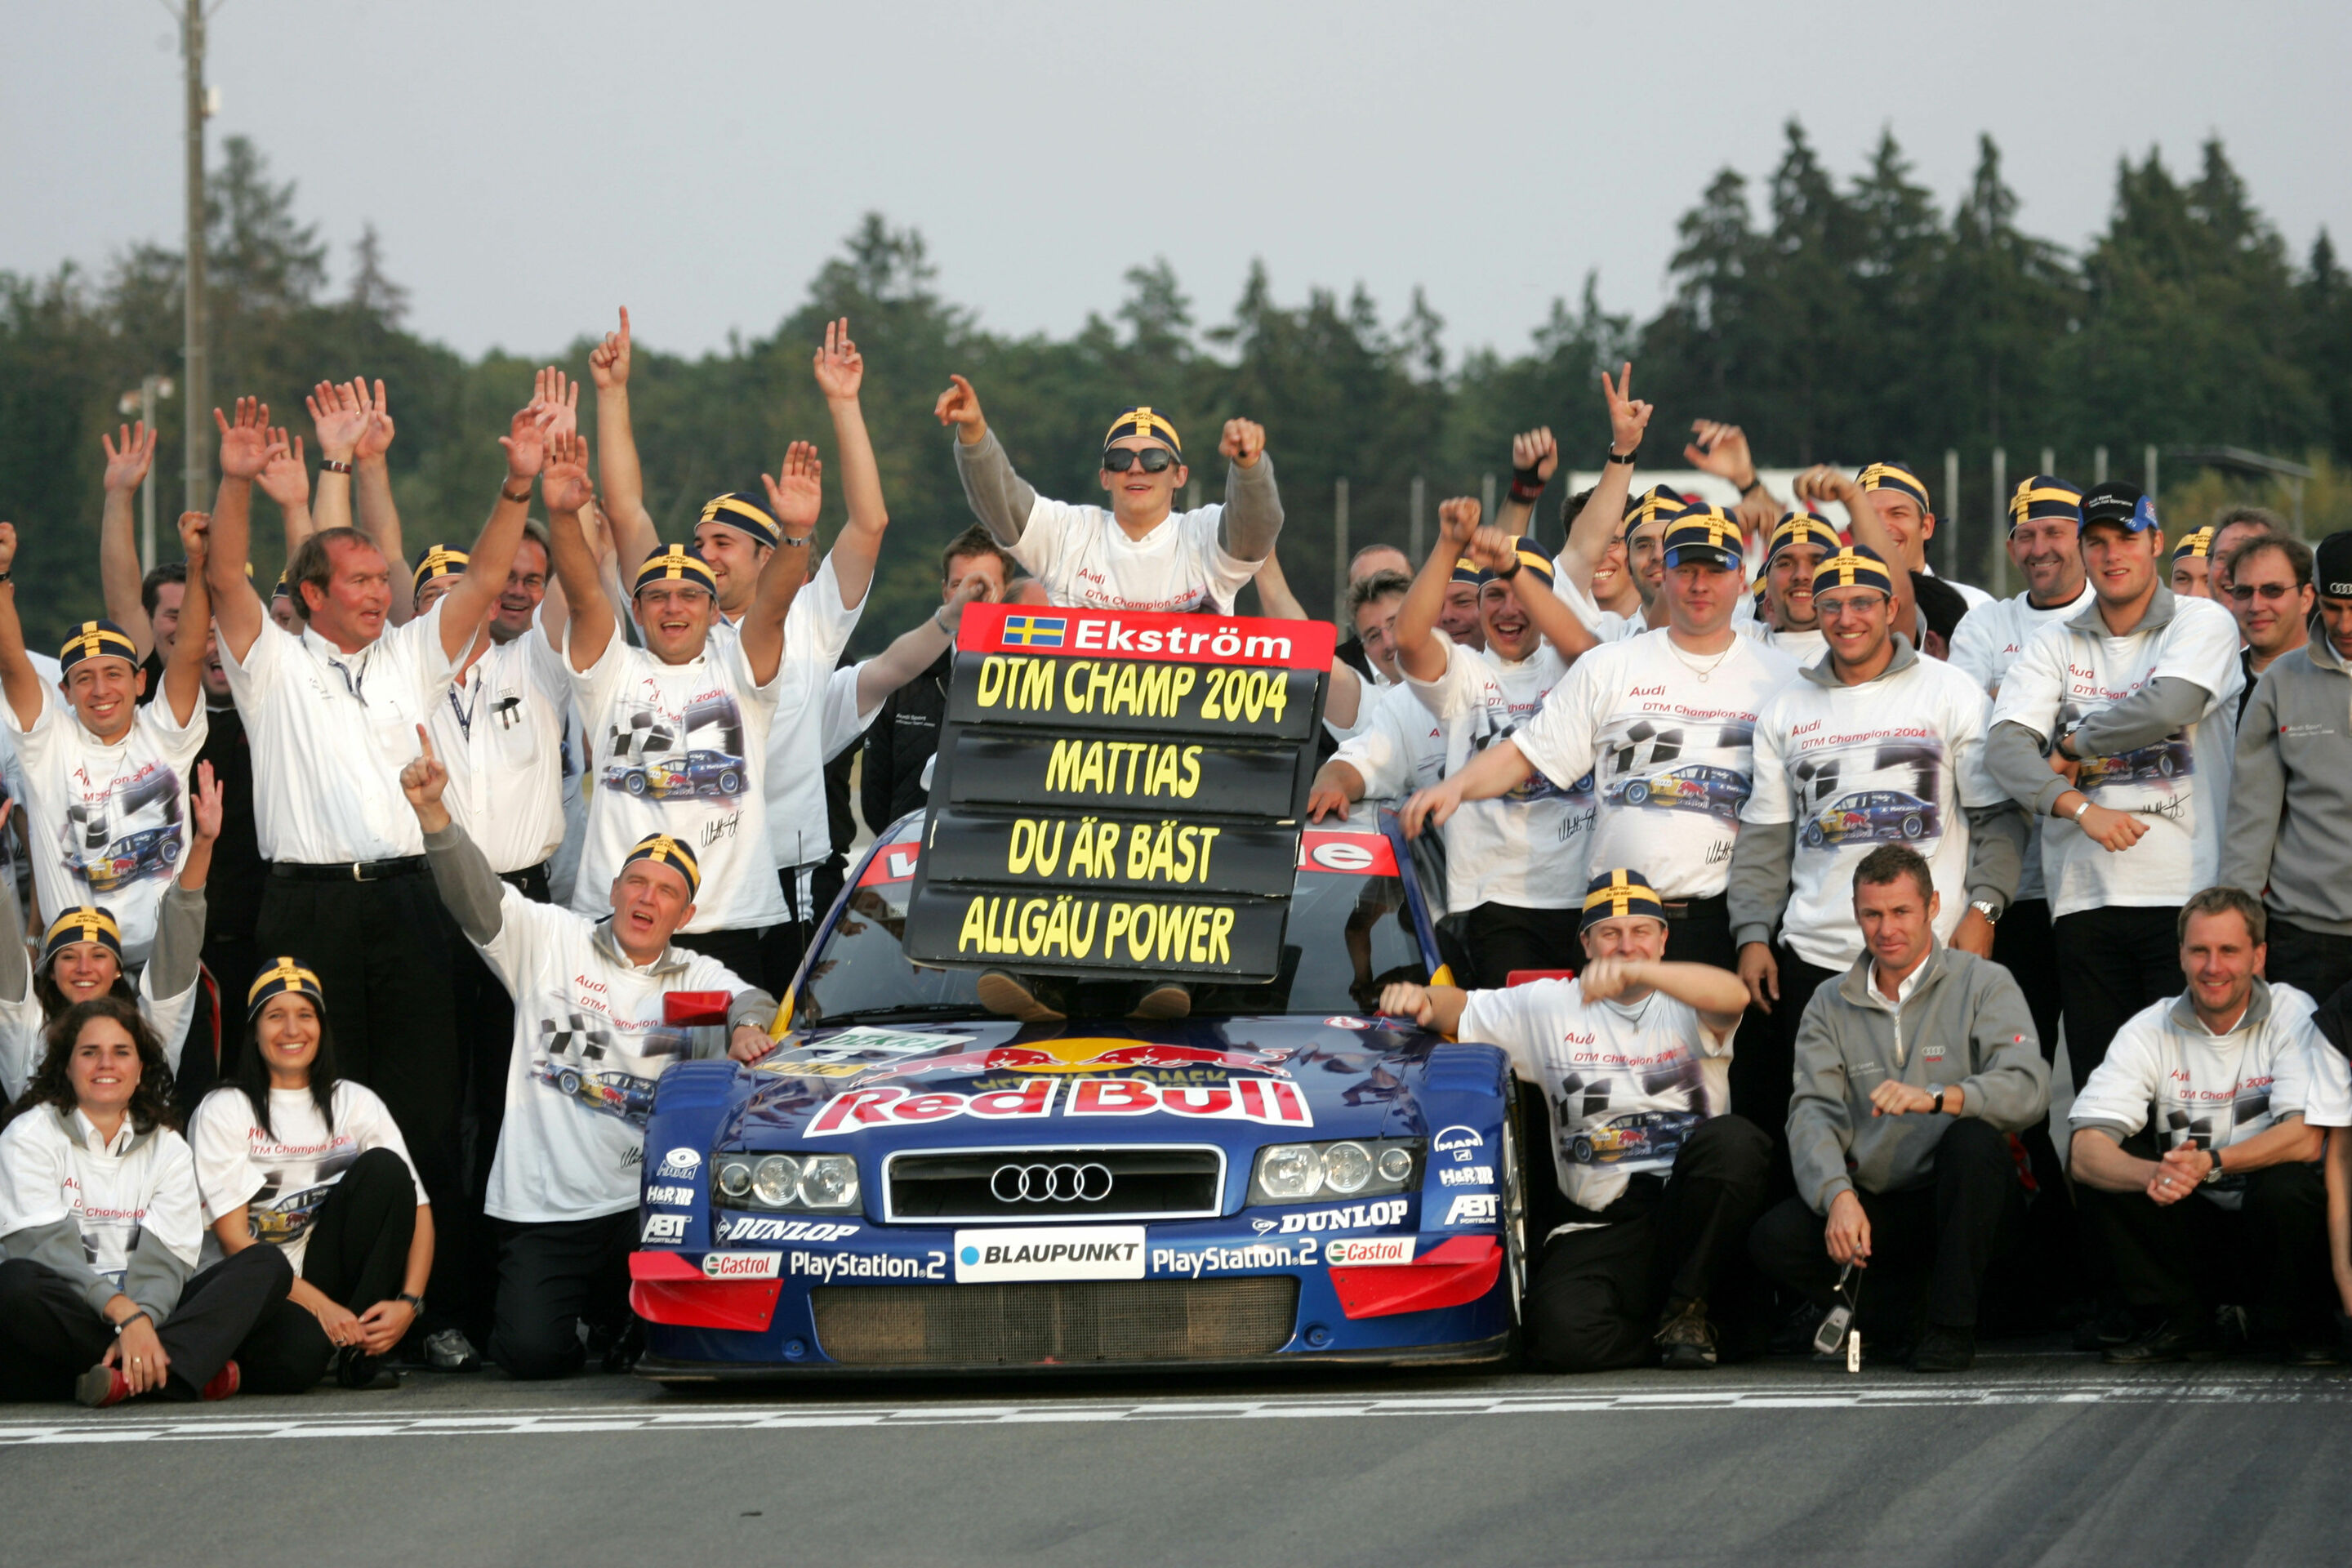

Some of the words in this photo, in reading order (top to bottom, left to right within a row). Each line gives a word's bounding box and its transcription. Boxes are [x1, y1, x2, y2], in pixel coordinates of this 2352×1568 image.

[1078, 568, 1106, 586] Audi
[1111, 595, 1171, 611] Champion
[1074, 619, 1293, 660] Ekström
[976, 656, 1057, 712] DTM
[1064, 661, 1196, 719] CHAMP
[1200, 668, 1288, 724] 2004
[1629, 685, 1665, 697] Audi
[1642, 702, 1671, 713] DTM
[1674, 705, 1736, 719] Champion
[1792, 719, 1821, 737] Audi
[1802, 738, 1824, 751] DTM
[1829, 729, 1890, 744] Champion
[1894, 728, 1927, 738] 2004
[1045, 739, 1203, 800] MATTIAS
[1008, 818, 1065, 877] DU
[1067, 817, 1117, 880] ÄR
[1127, 819, 1220, 884] BÄST
[958, 895, 1098, 959] ALLGÄU
[1104, 902, 1235, 965] POWER
[580, 996, 607, 1012] DTM
[818, 1033, 949, 1049] DEKRA
[1565, 1031, 1595, 1045] Audi
[1575, 1053, 1598, 1062] DTM
[803, 1078, 1062, 1138] Red
[1063, 1077, 1314, 1128] Bull
[1438, 1138, 1479, 1152] MAN
[1439, 1166, 1477, 1187] H&R
[646, 1185, 675, 1205] H&R
[1279, 1200, 1408, 1234] DUNLOP
[1444, 1194, 1497, 1225] ABT
[641, 1214, 687, 1243] ABT
[727, 1218, 860, 1241] DUNLOP
[984, 1243, 1139, 1264] BLAUPUNKT
[1348, 1242, 1403, 1260] Castrol
[720, 1256, 770, 1274] Castrol
